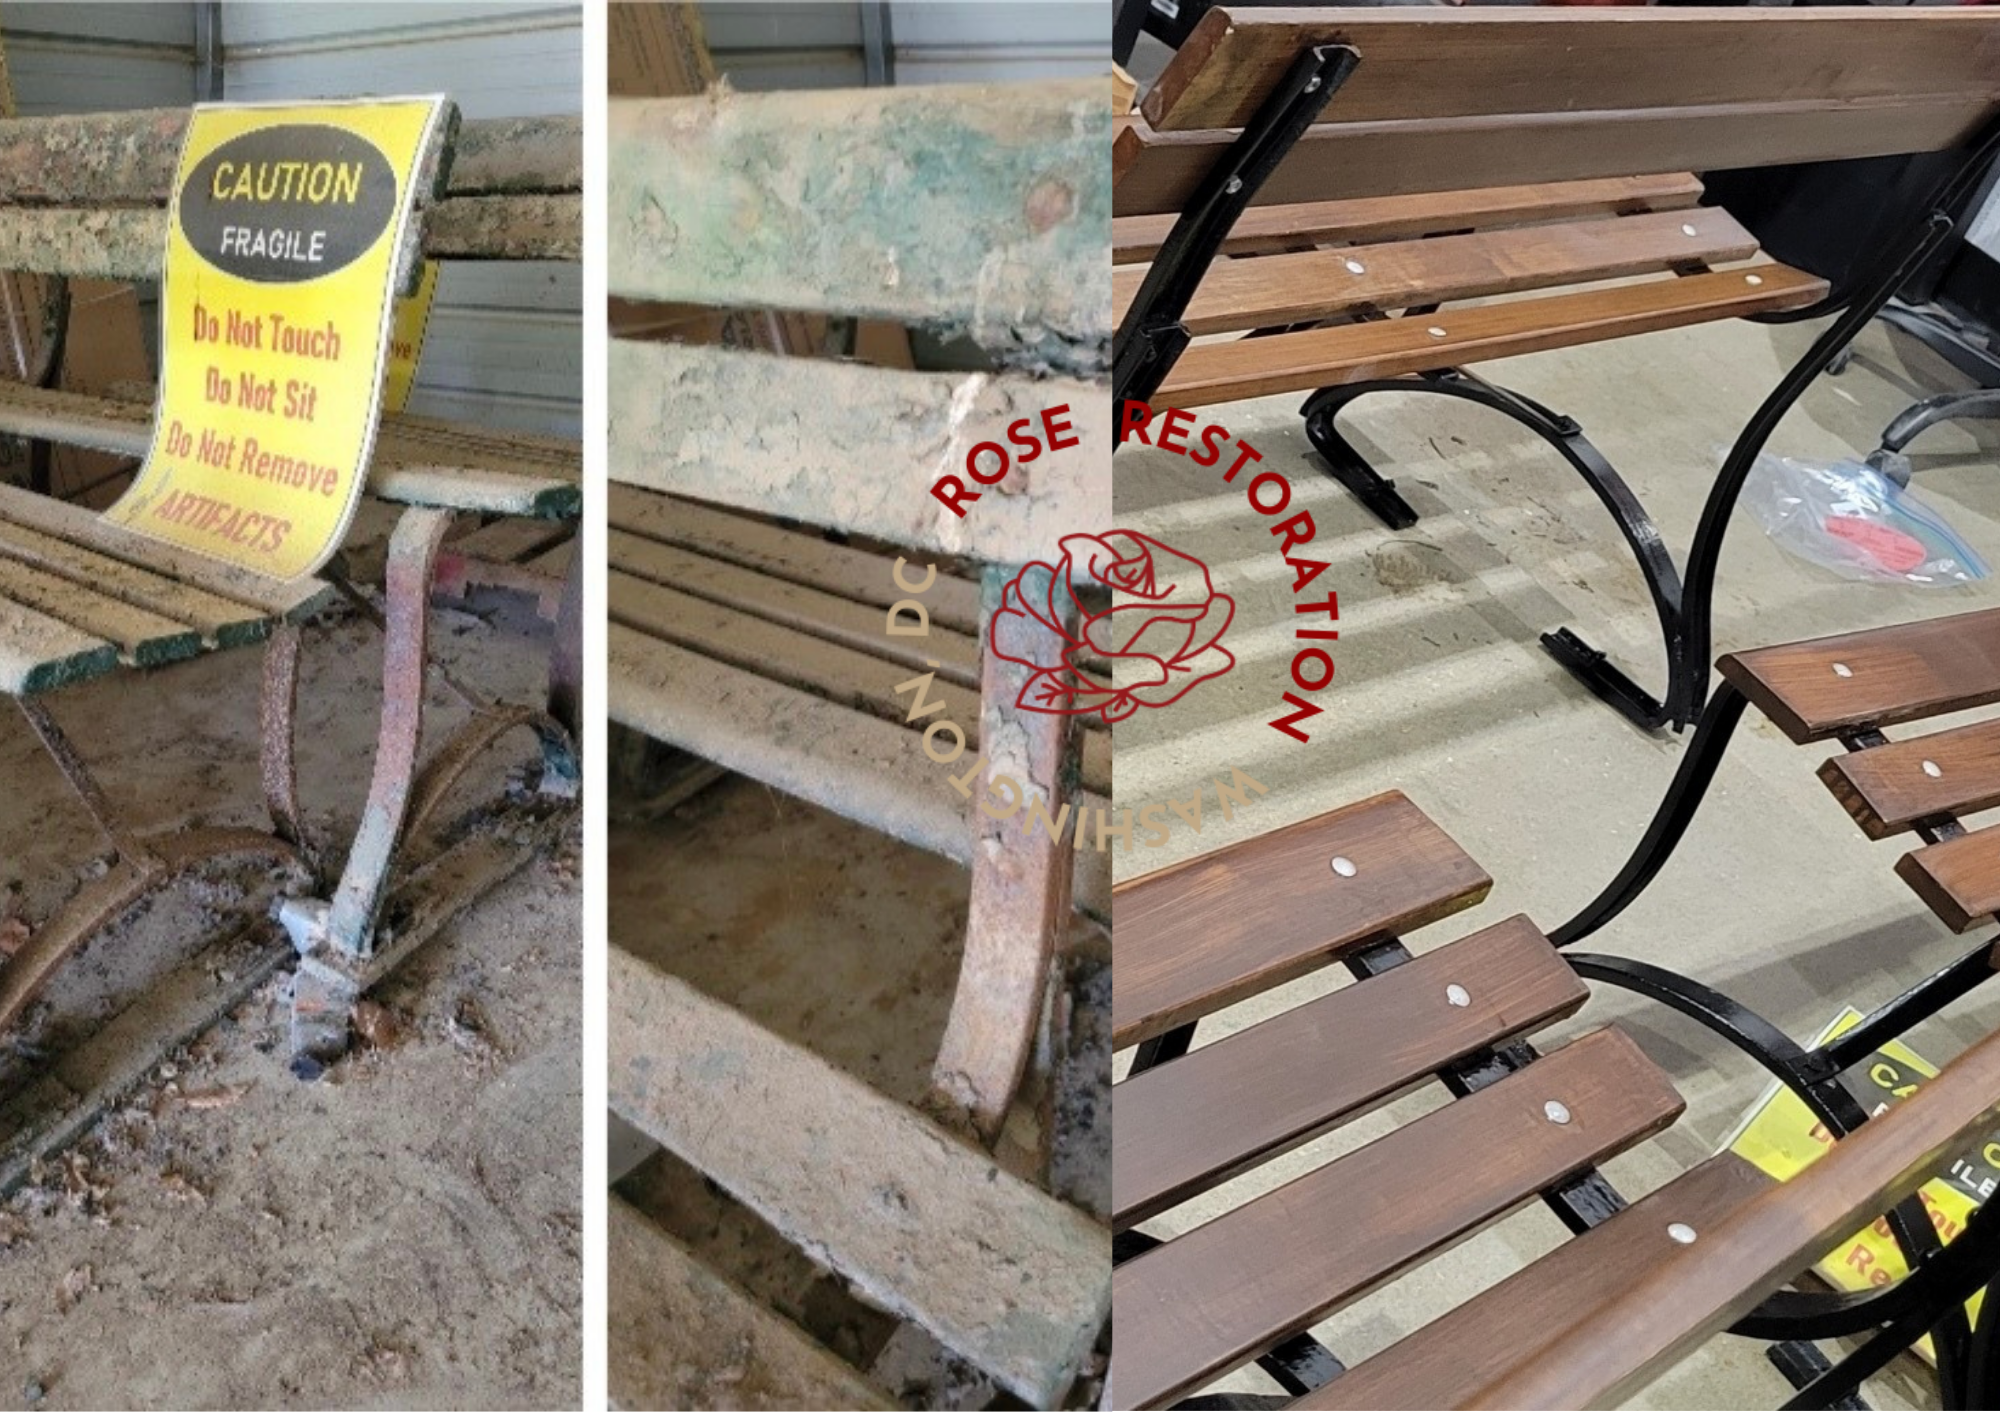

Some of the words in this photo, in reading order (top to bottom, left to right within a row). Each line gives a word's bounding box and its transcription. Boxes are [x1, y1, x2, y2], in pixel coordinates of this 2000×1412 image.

[213, 161, 363, 203] CAUTION
[221, 225, 326, 262] FRAGILE
[194, 303, 219, 343] Do
[226, 308, 263, 350] Not
[269, 313, 342, 361] Touch
[206, 365, 231, 405] Do
[238, 372, 277, 414] Not
[283, 379, 317, 422] Sit
[165, 420, 192, 458] Do
[197, 428, 236, 471] Not
[239, 437, 339, 497] Remove
[153, 488, 292, 552] ARTIFACTS
